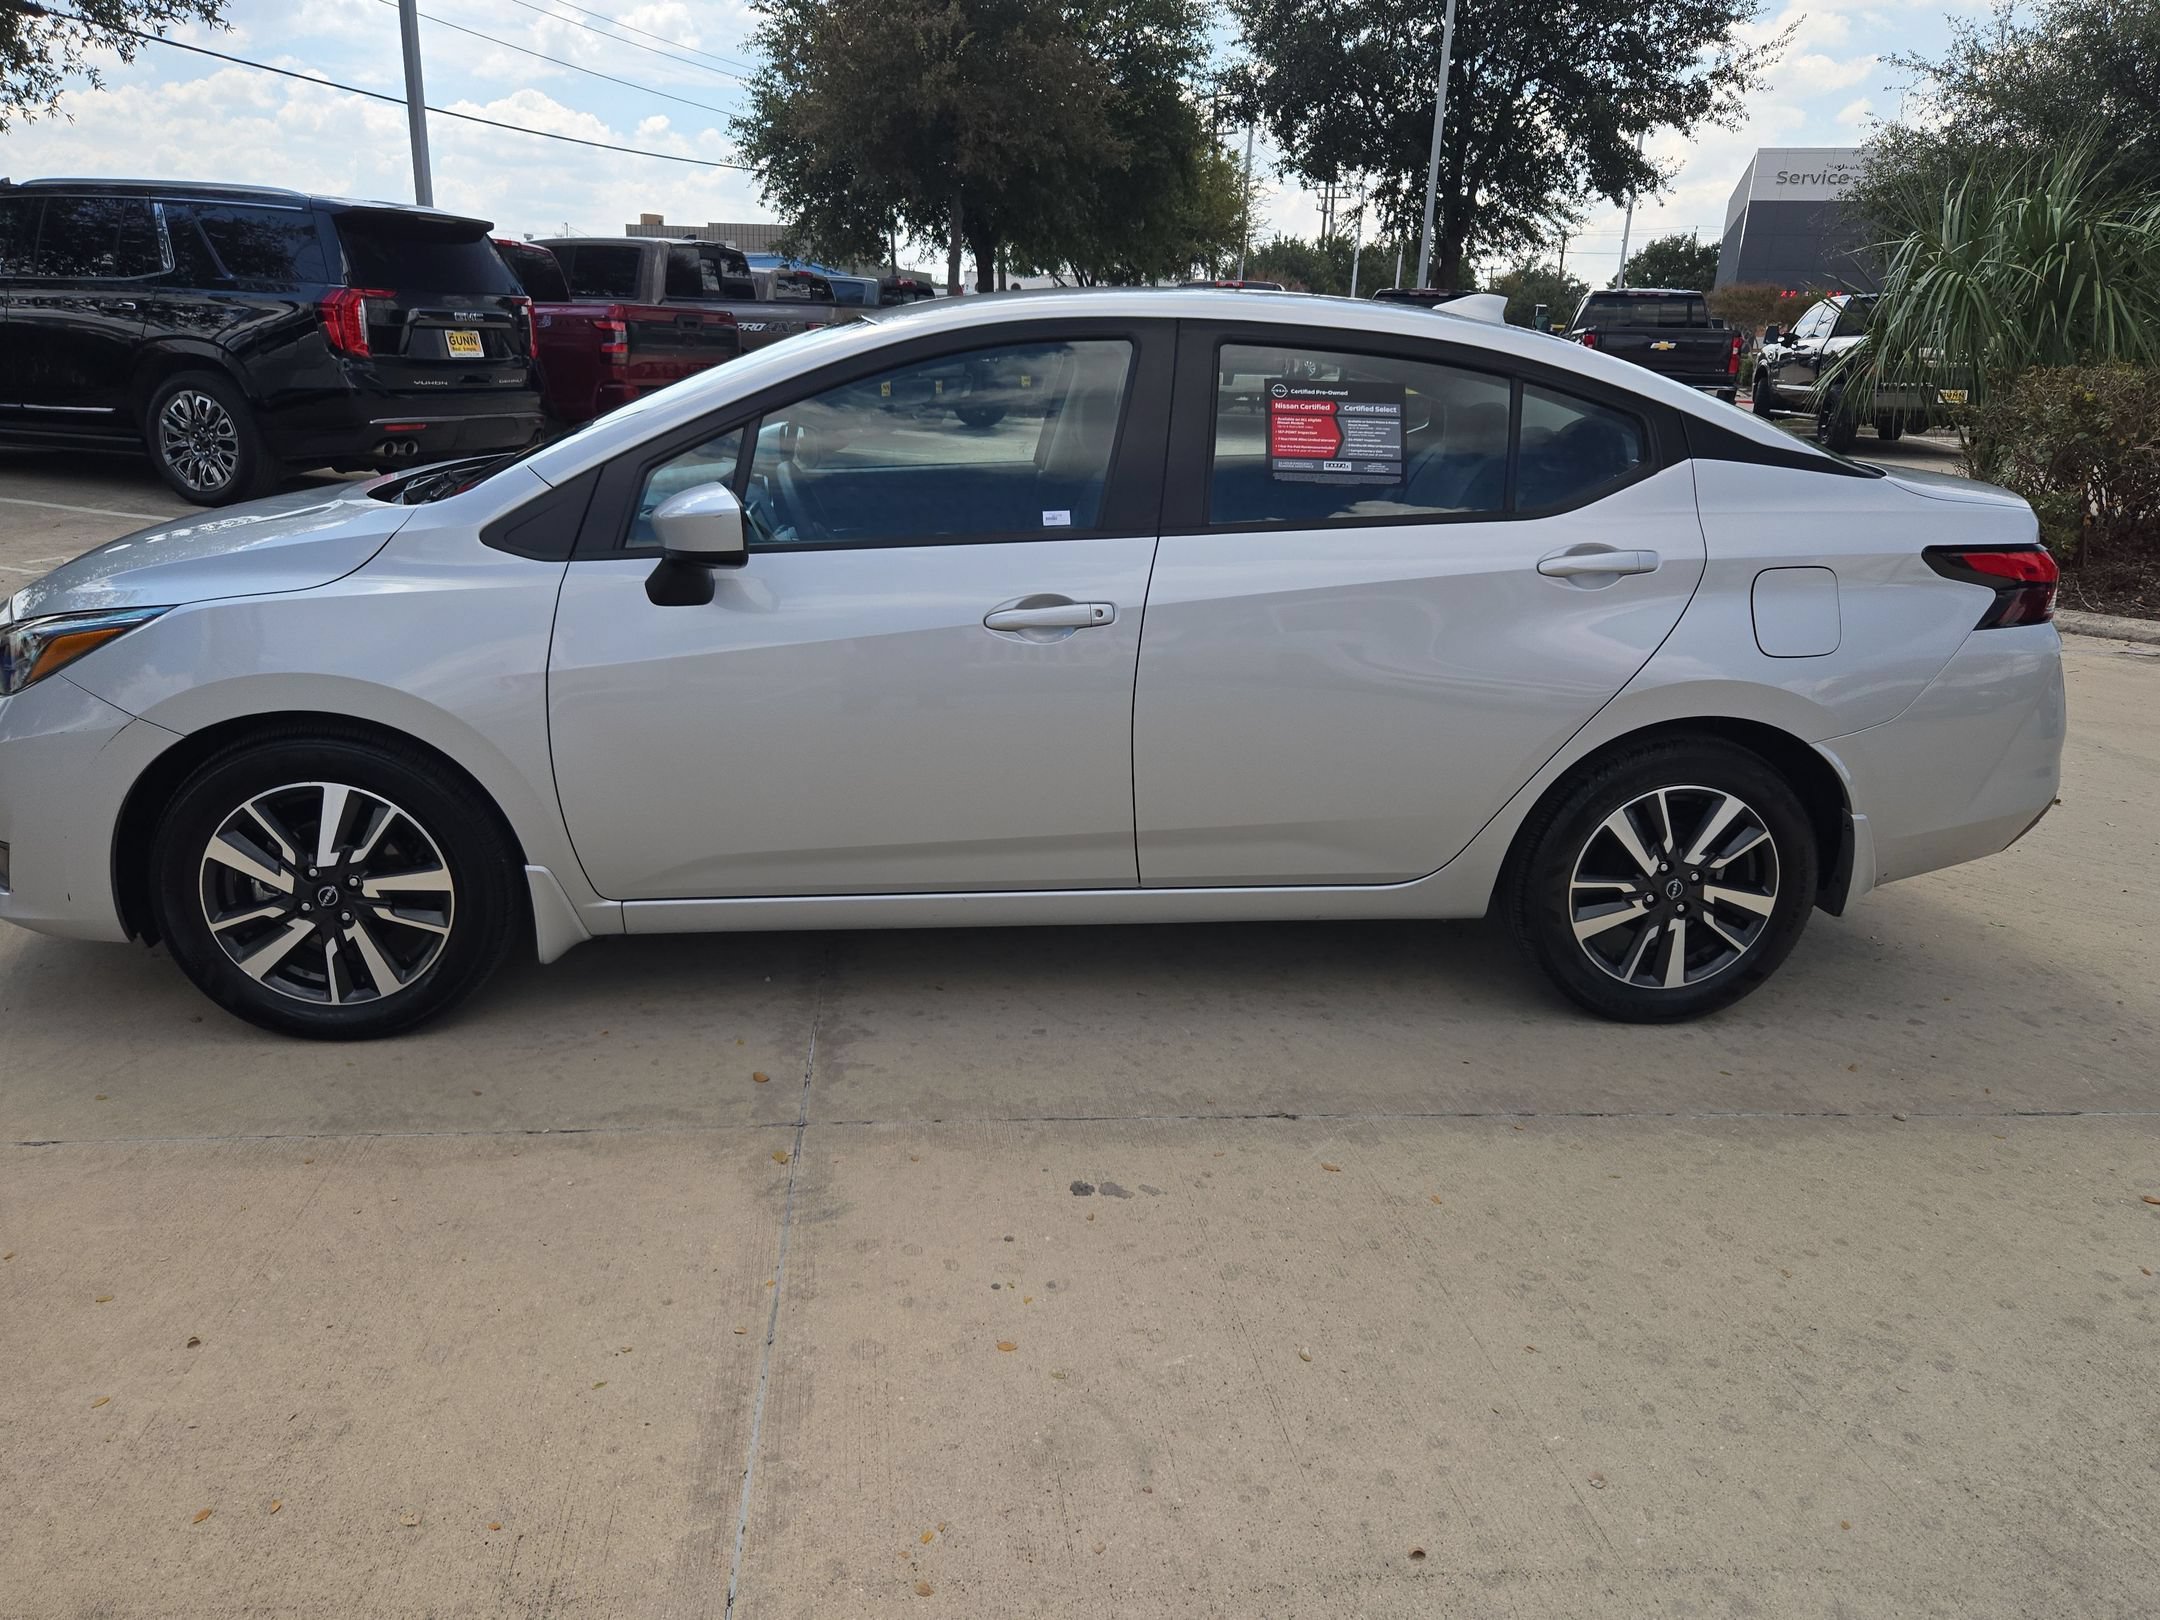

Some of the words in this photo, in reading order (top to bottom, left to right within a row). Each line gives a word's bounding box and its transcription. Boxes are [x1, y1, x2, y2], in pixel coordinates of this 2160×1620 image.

[1776, 170, 1849, 185] Service
[449, 335, 477, 346] GUNN
[1275, 402, 1299, 410] Nissan
[1300, 403, 1331, 411] Certified
